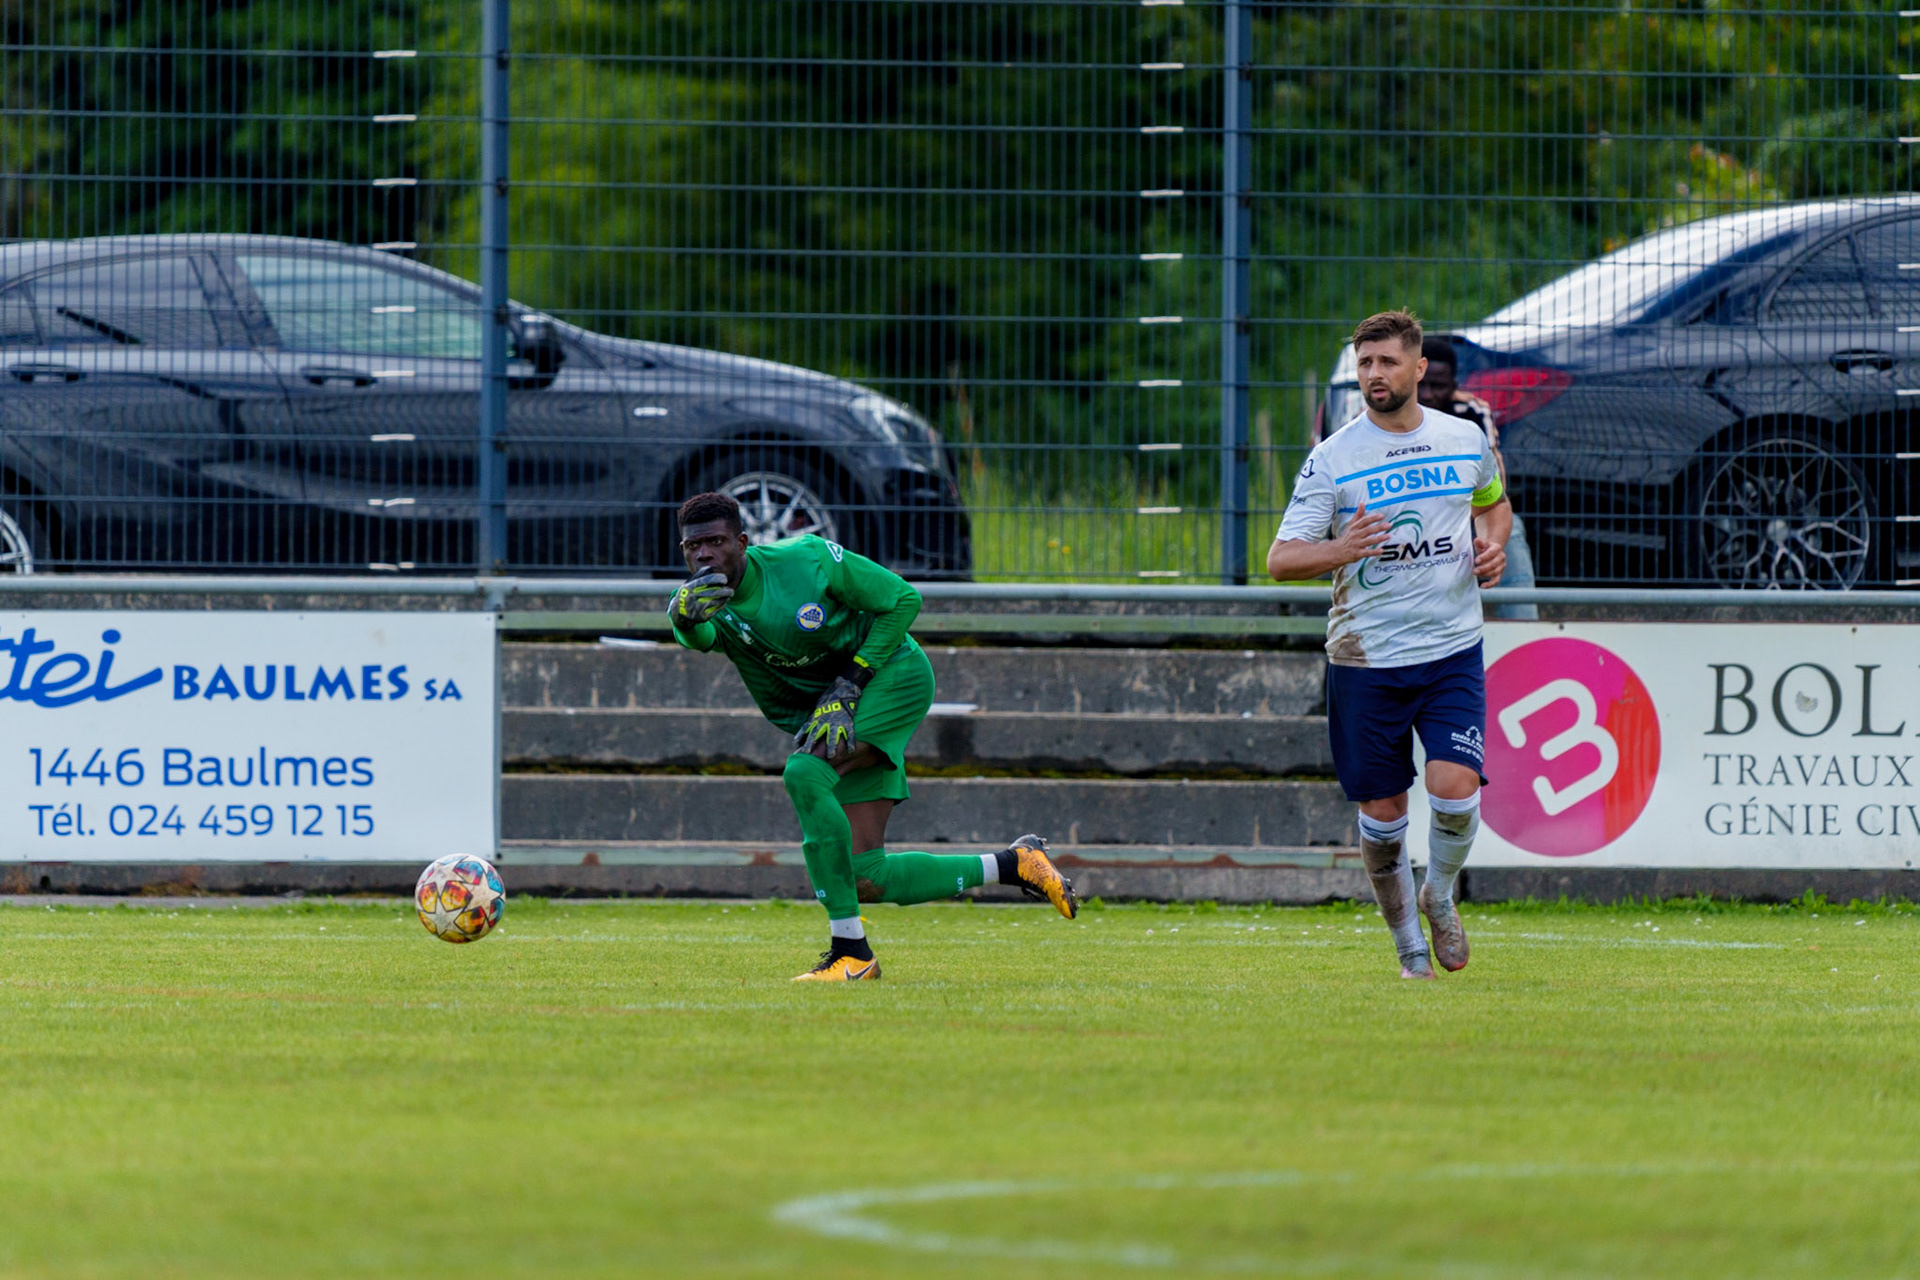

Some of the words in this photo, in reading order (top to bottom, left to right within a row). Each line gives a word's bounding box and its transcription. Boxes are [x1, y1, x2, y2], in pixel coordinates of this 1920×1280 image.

[1366, 465, 1461, 500] BOSNA
[1378, 535, 1454, 562] SMS
[173, 664, 410, 702] BAULMES
[424, 679, 463, 701] SA
[1703, 662, 1920, 738] BOL
[28, 748, 145, 787] 1446
[162, 746, 374, 787] Baulmes
[1704, 753, 1913, 787] TRAVAUX
[28, 803, 95, 836] Tél.
[108, 804, 186, 836] 024
[198, 804, 274, 836] 459
[286, 804, 324, 836] 12
[335, 804, 375, 836] 15
[1705, 796, 1842, 836] GÉNIE
